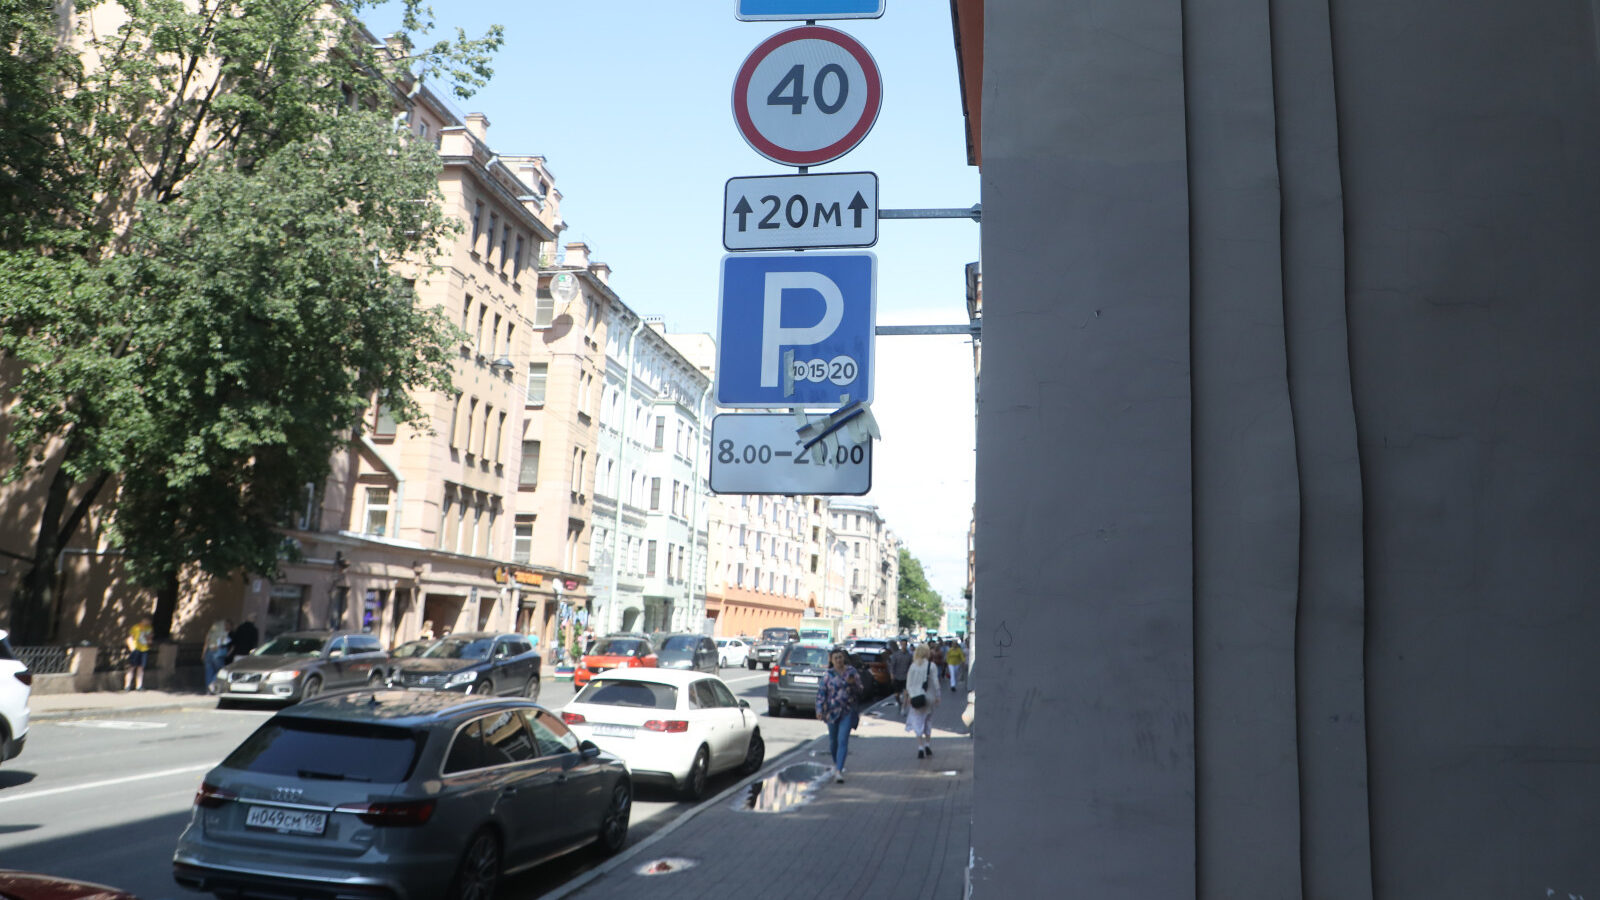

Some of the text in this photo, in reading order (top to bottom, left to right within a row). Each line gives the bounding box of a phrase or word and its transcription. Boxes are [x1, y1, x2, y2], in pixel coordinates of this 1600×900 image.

[767, 63, 849, 115] 40
[760, 271, 844, 388] P
[793, 362, 855, 380] 10 15 20
